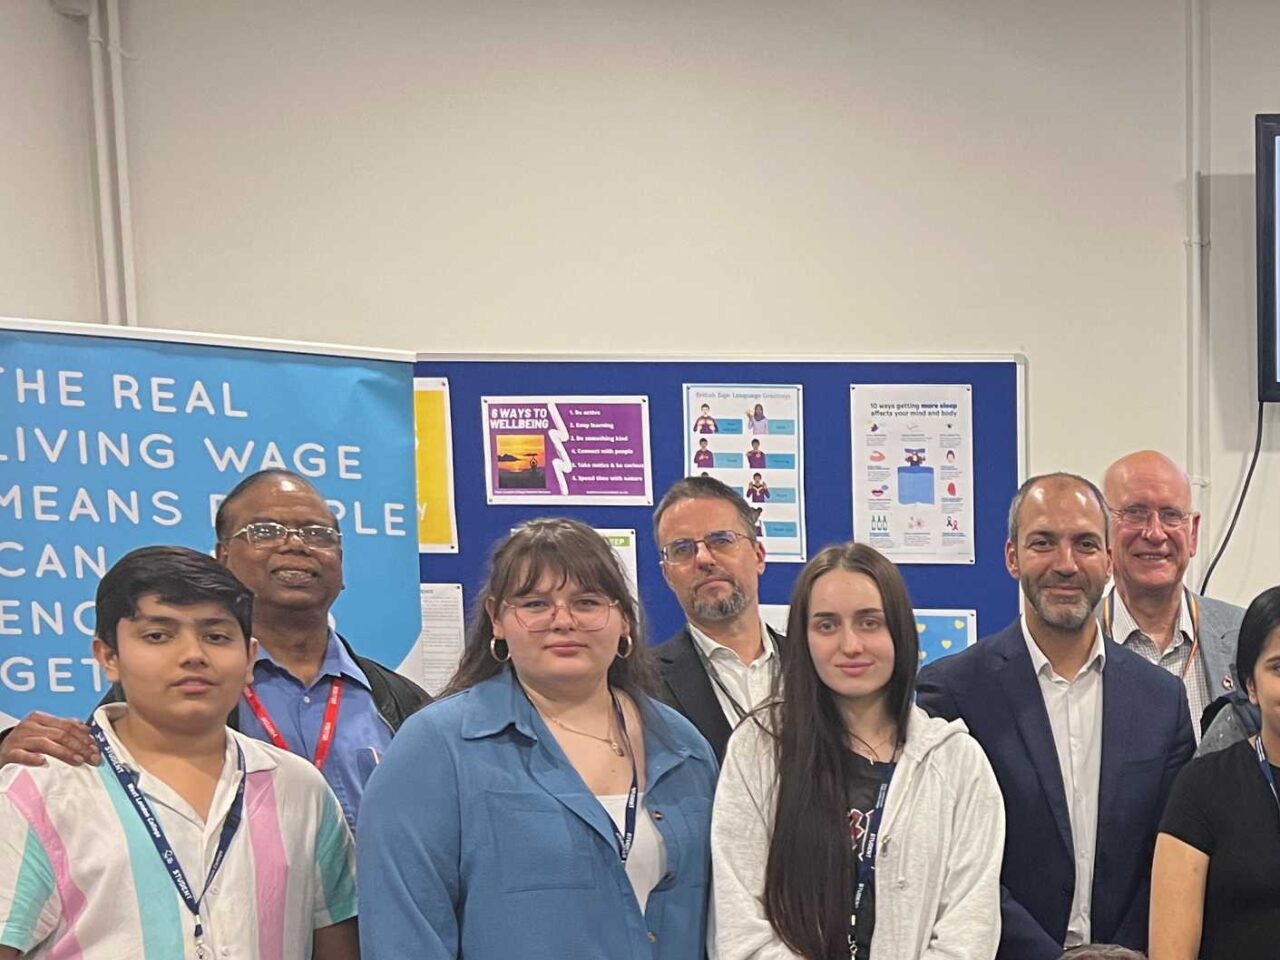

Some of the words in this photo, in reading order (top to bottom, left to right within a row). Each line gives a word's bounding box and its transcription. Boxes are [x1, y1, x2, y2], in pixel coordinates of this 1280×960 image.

[0, 367, 86, 407] HE
[112, 373, 247, 418] REAL
[896, 403, 920, 411] getting
[490, 419, 549, 430] WELLBEING
[491, 408, 499, 419] 6
[499, 408, 531, 419] WAYS
[534, 408, 548, 419] TO
[203, 436, 363, 480] WAGE
[104, 745, 125, 774] STUDENT
[127, 782, 139, 798] West
[137, 793, 151, 819] London
[147, 814, 162, 839] College
[172, 869, 193, 901] STUDENT
